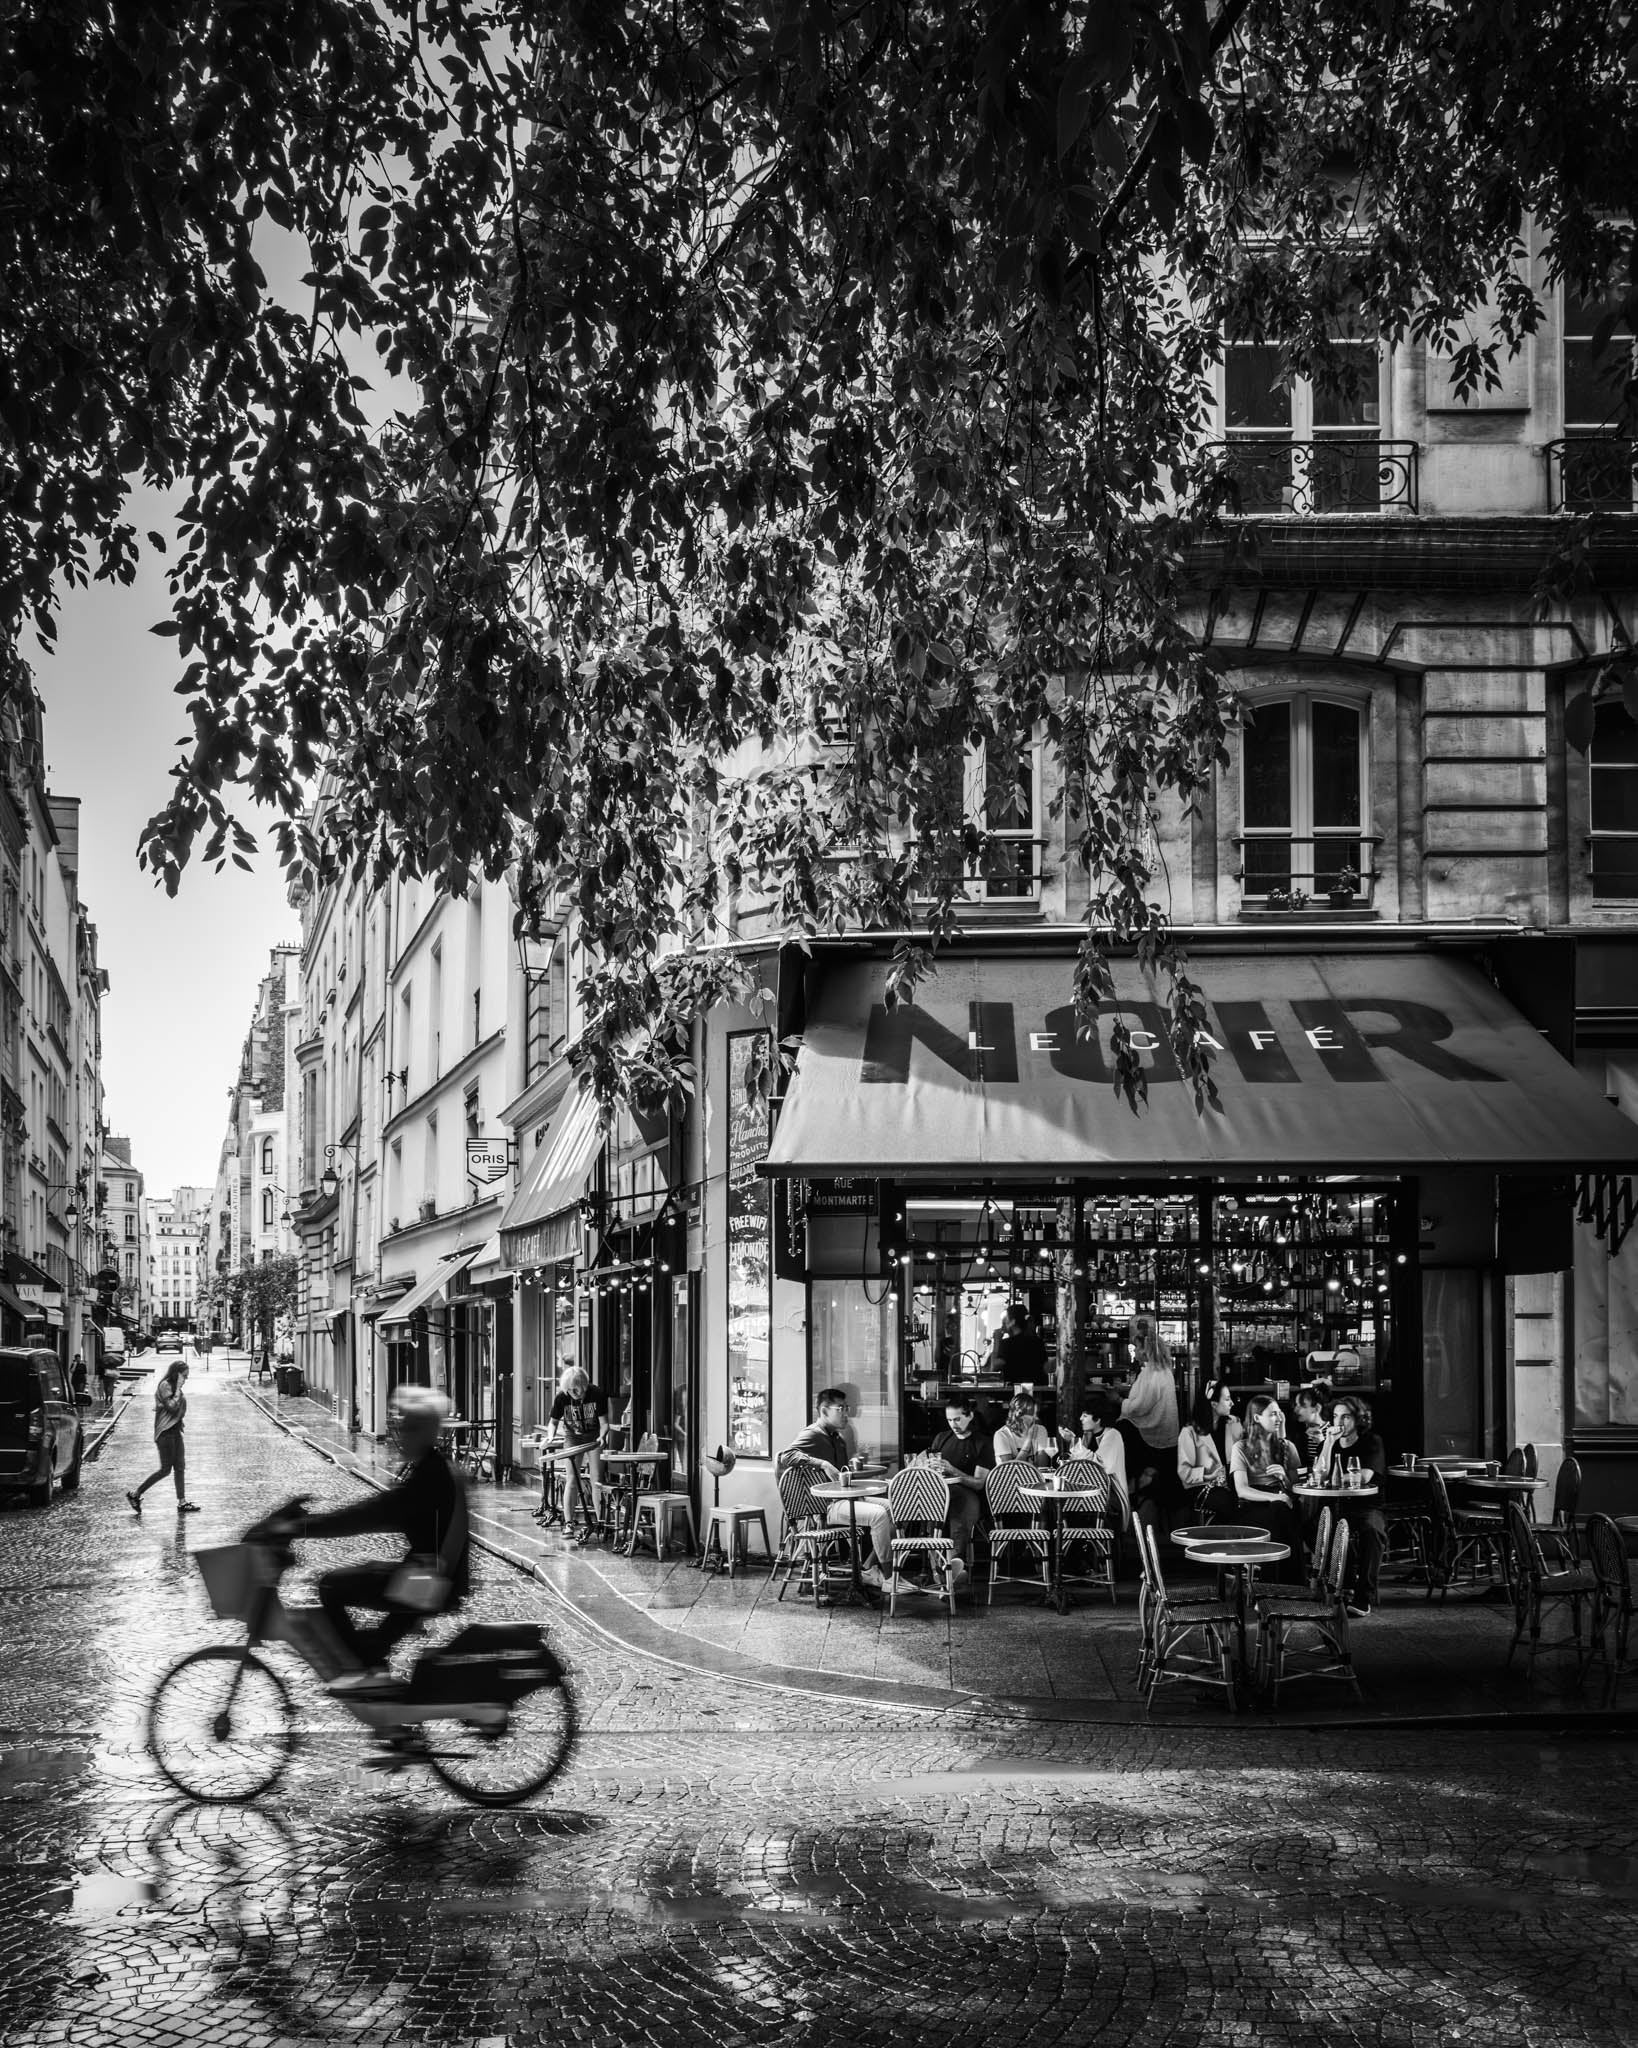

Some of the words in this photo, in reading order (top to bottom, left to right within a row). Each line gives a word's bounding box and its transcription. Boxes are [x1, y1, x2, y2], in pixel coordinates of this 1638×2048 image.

[860, 999, 1508, 1083] NOIR
[968, 1031, 1060, 1051] LE
[1128, 1026, 1344, 1051] CAFÉ
[471, 1154, 505, 1164] ORIS
[730, 1142, 769, 1159] PRODUITS
[834, 1178, 853, 1189] RUE
